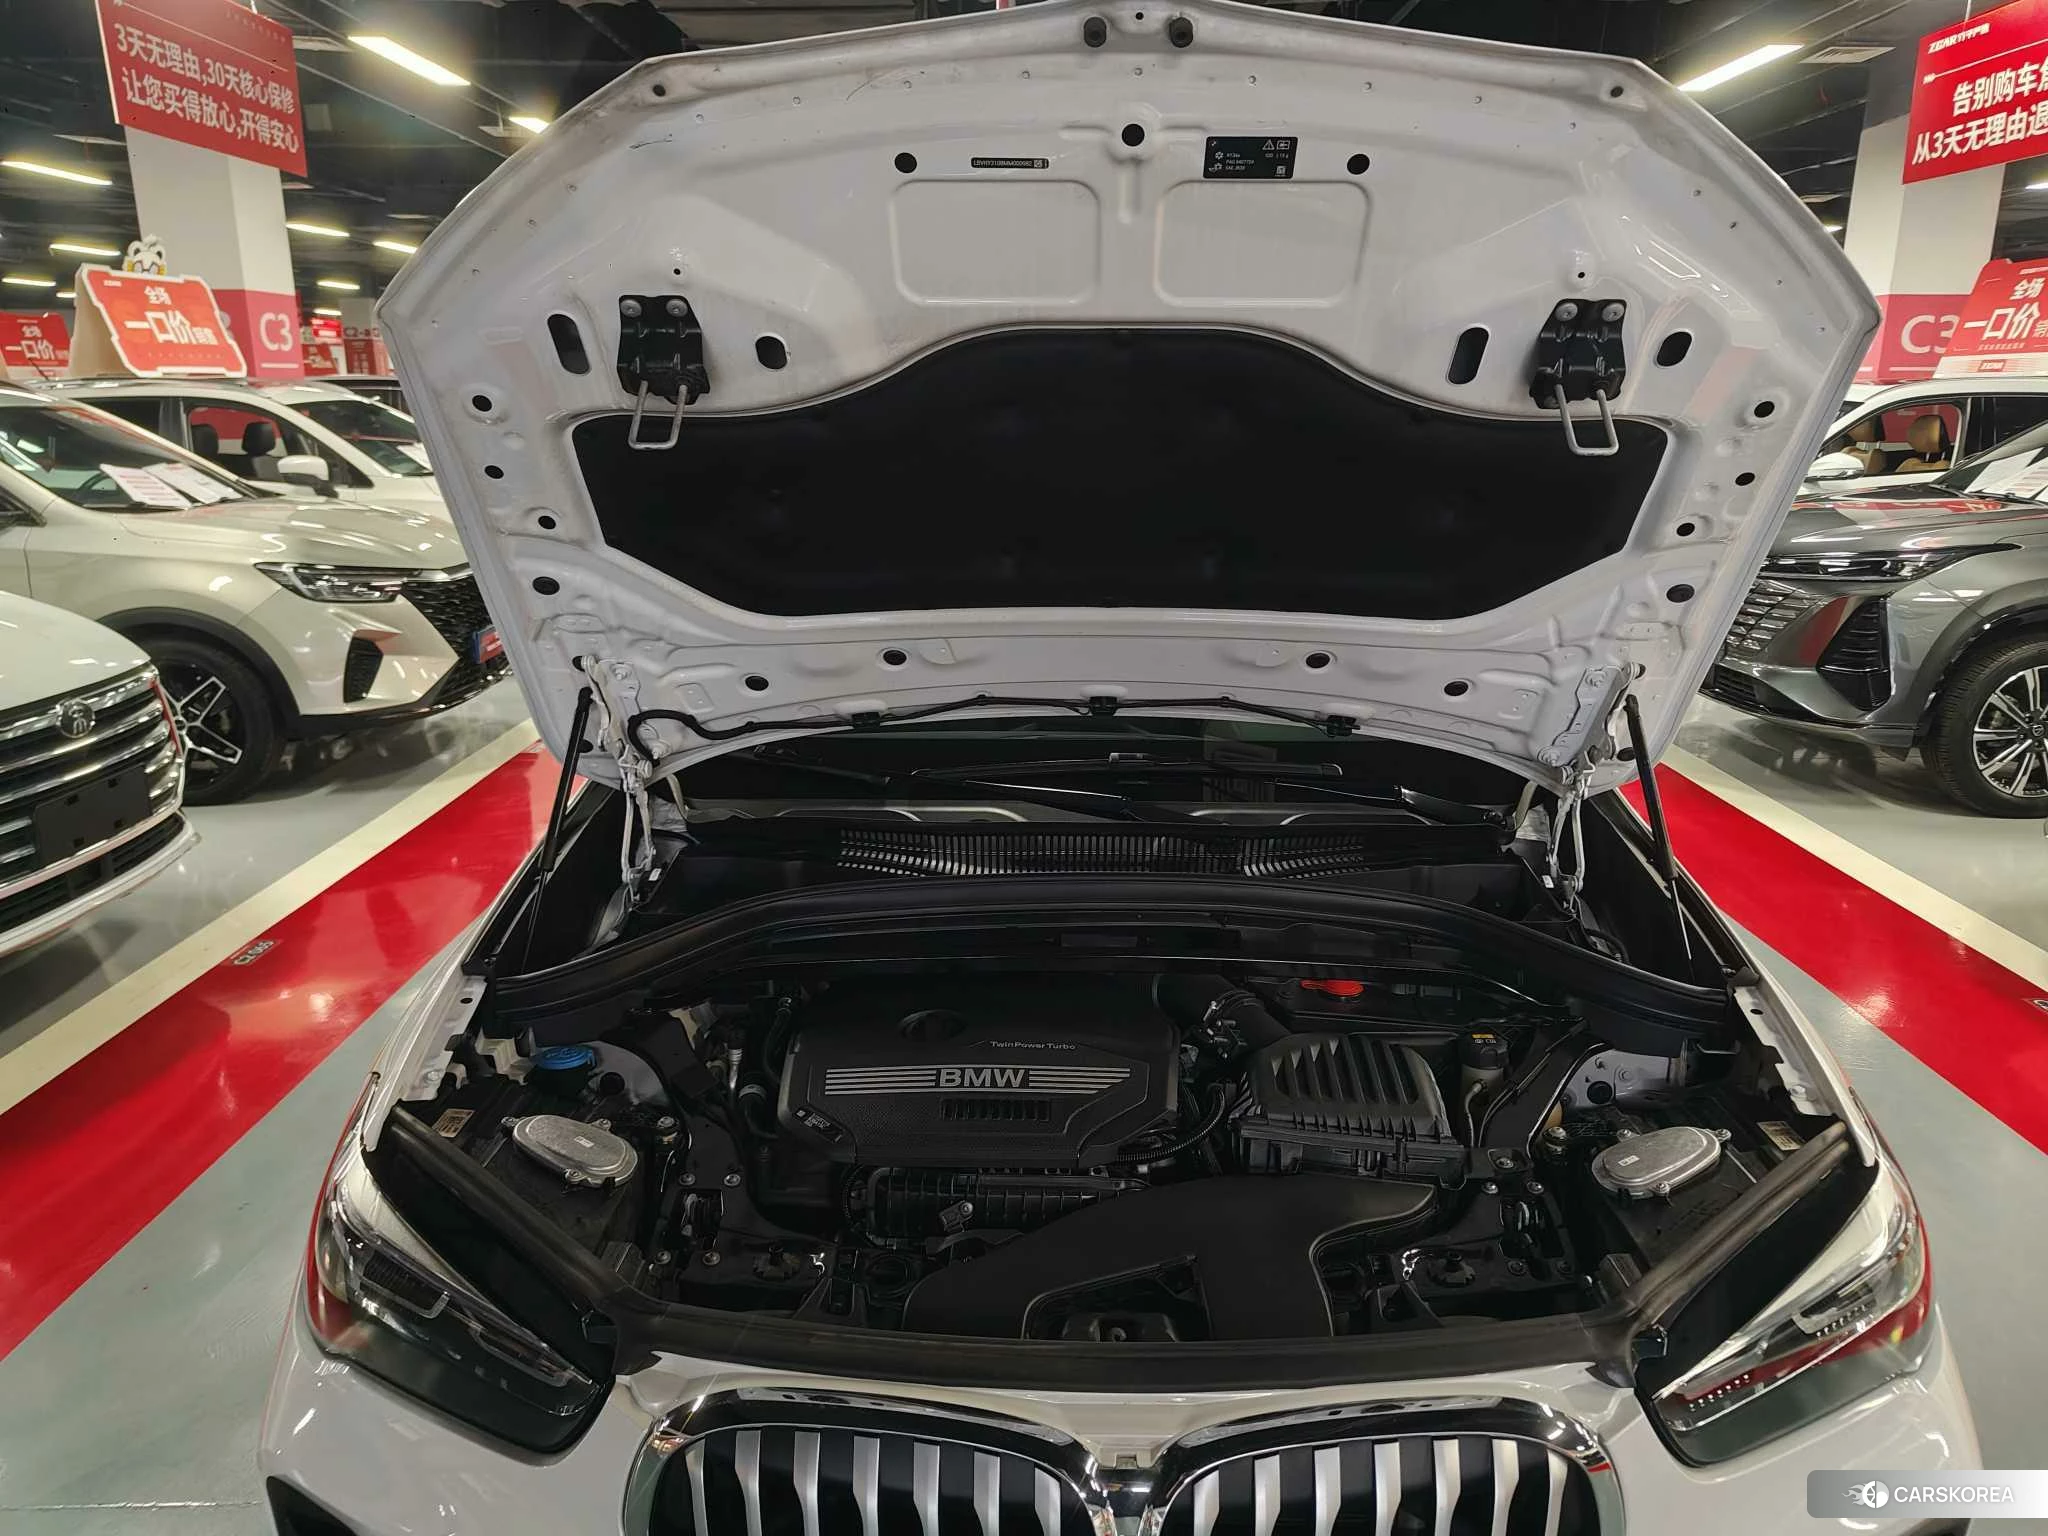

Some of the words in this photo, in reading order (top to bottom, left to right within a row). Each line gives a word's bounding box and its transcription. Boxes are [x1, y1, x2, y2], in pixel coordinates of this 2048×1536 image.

[260, 312, 293, 351] C3
[1901, 314, 1960, 354] C3
[938, 1068, 1026, 1088] BMW
